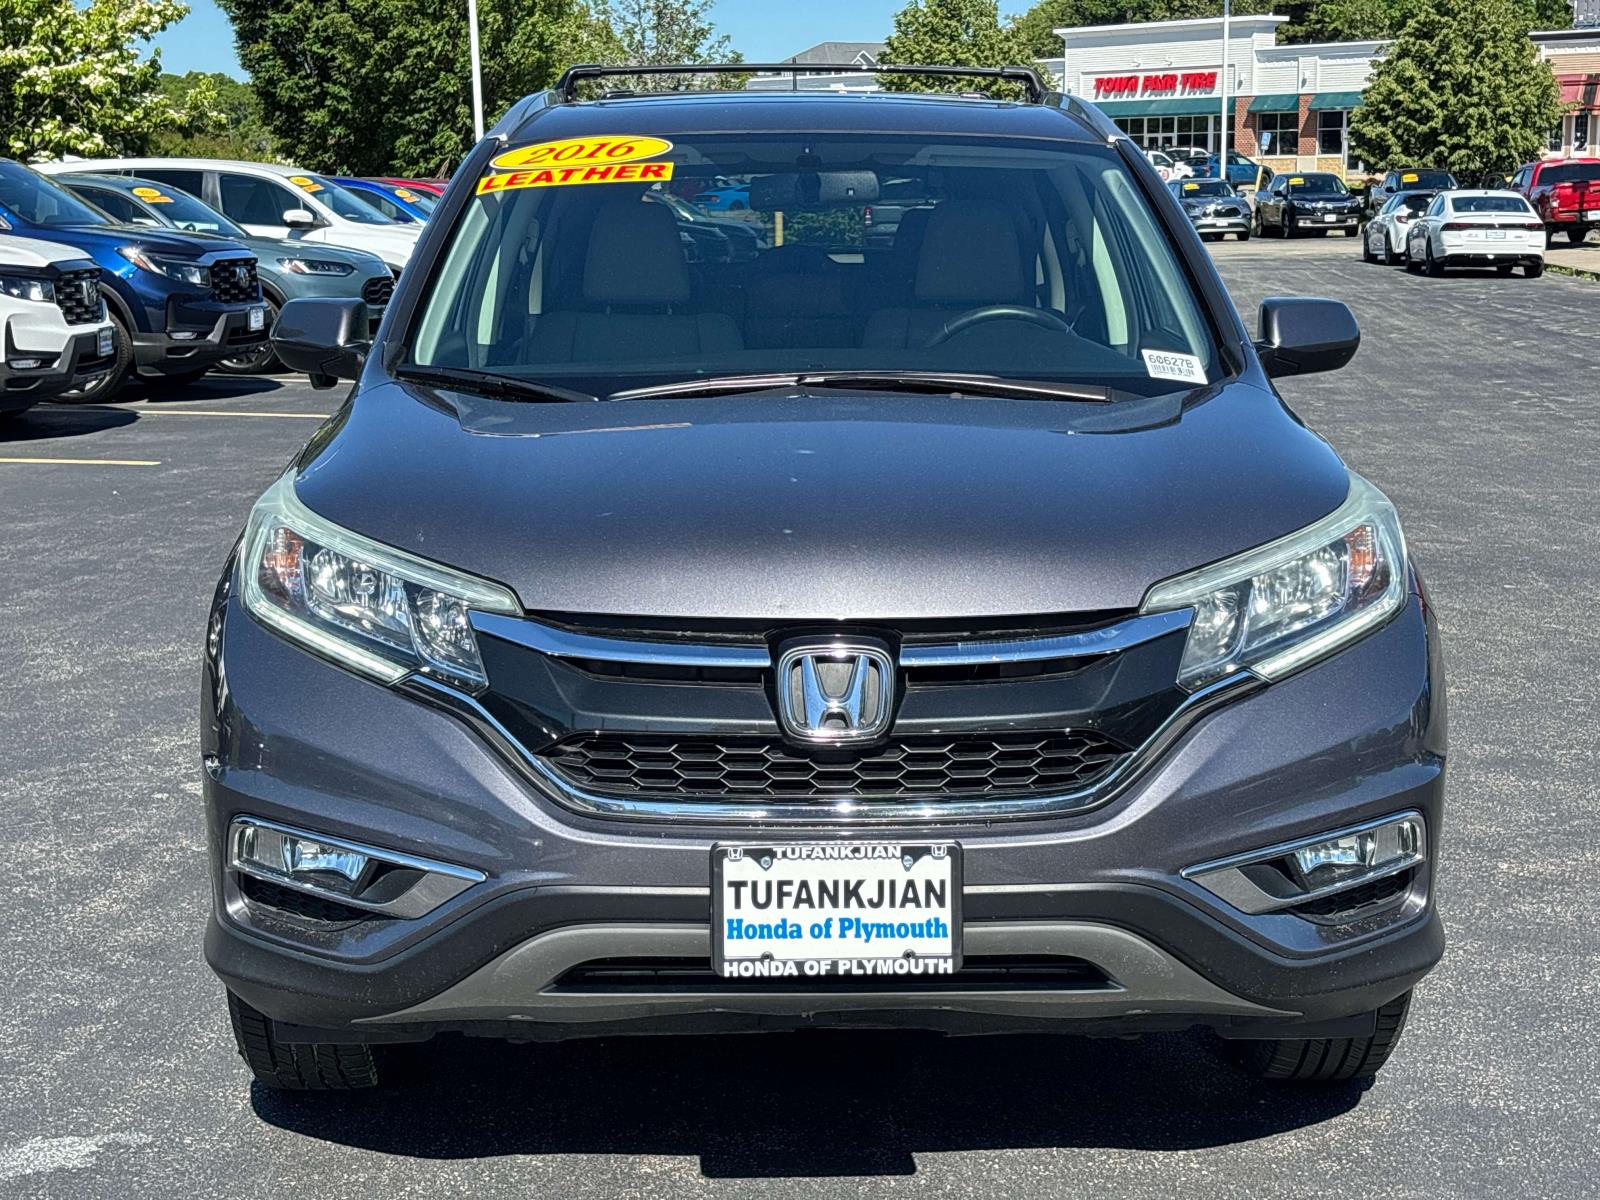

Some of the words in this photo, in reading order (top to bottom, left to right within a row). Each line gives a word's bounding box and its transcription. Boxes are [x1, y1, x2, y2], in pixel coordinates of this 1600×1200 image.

[1094, 76, 1139, 93] TOWN
[1142, 74, 1178, 91] FAIR
[1181, 72, 1217, 89] TIRE
[519, 139, 644, 165] 2016
[481, 164, 668, 192] LEATHER
[773, 845, 901, 860] TUFANKJIAN
[727, 879, 947, 909] TUFANKJIAN
[726, 918, 802, 940] Honda
[809, 917, 833, 939] of
[838, 917, 949, 943] Plymouth
[724, 961, 798, 977] HONDA
[804, 960, 833, 976] OF
[838, 958, 952, 975] PLYMOUTH
